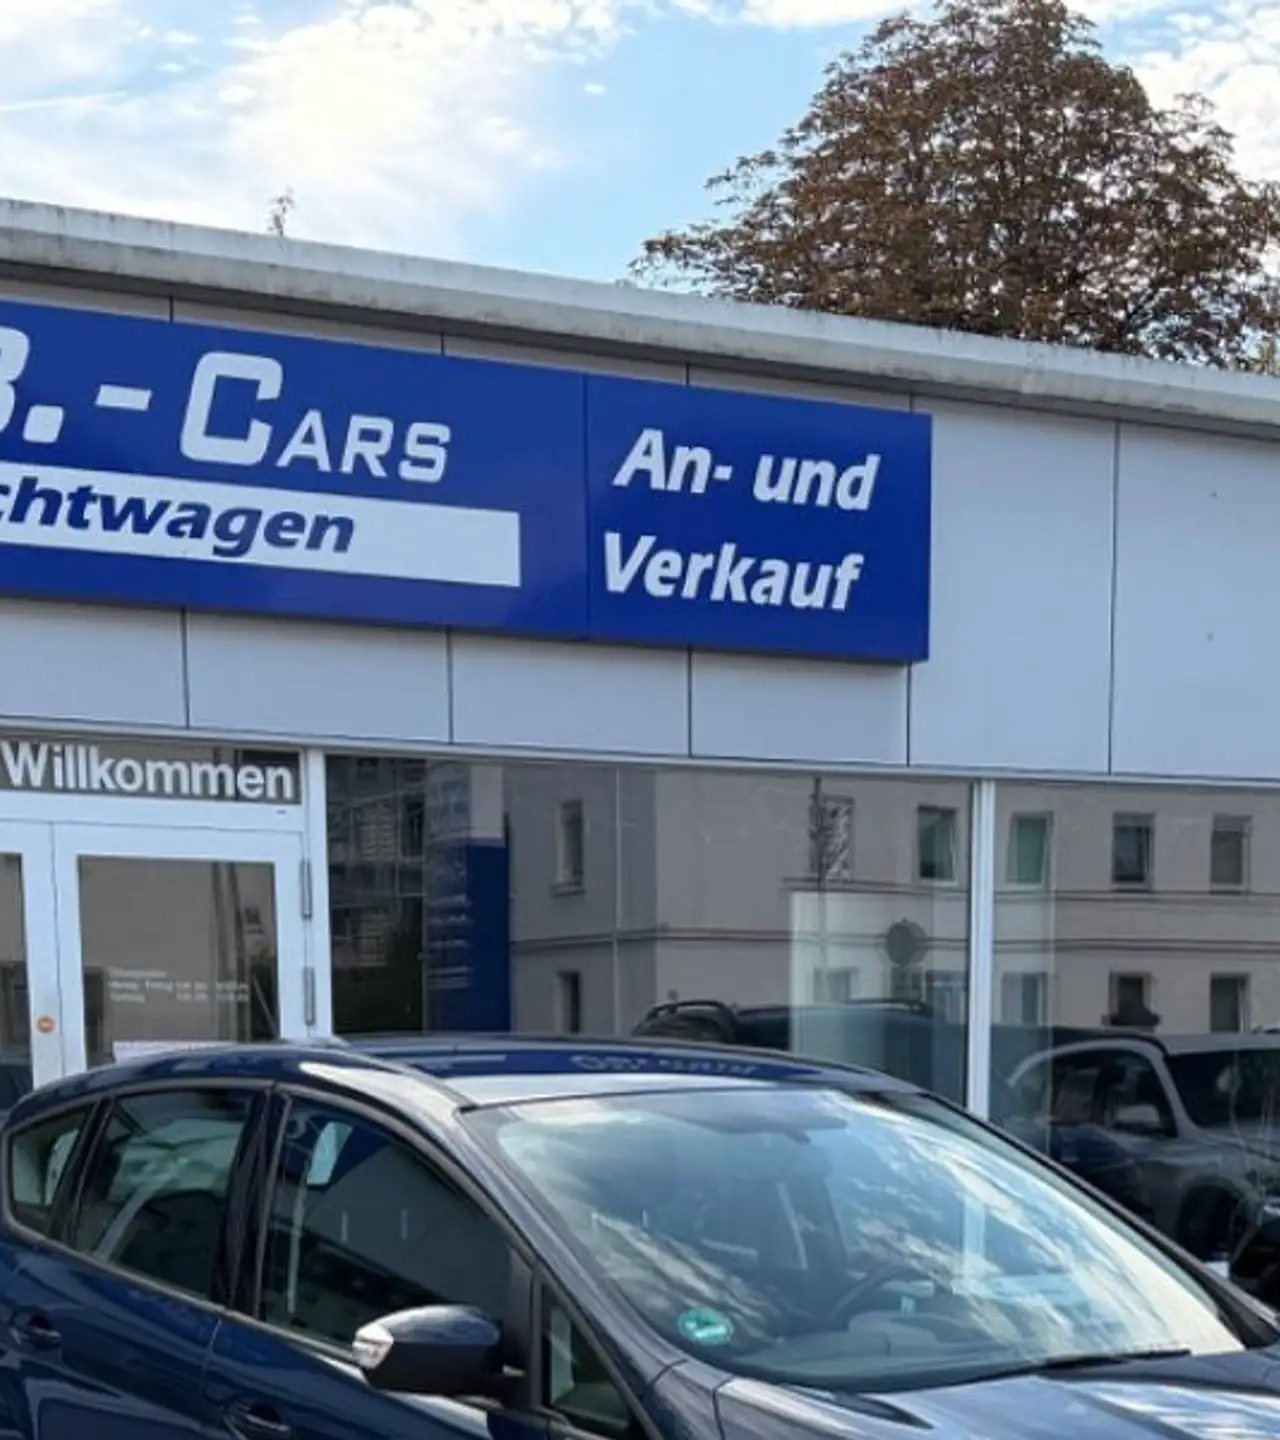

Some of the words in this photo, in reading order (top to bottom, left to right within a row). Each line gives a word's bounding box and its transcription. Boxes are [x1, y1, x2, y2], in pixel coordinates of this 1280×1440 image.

[612, 428, 731, 494] An-
[753, 454, 881, 511] und
[604, 532, 863, 611] Verkauf
[0, 738, 296, 800] Willkommen
